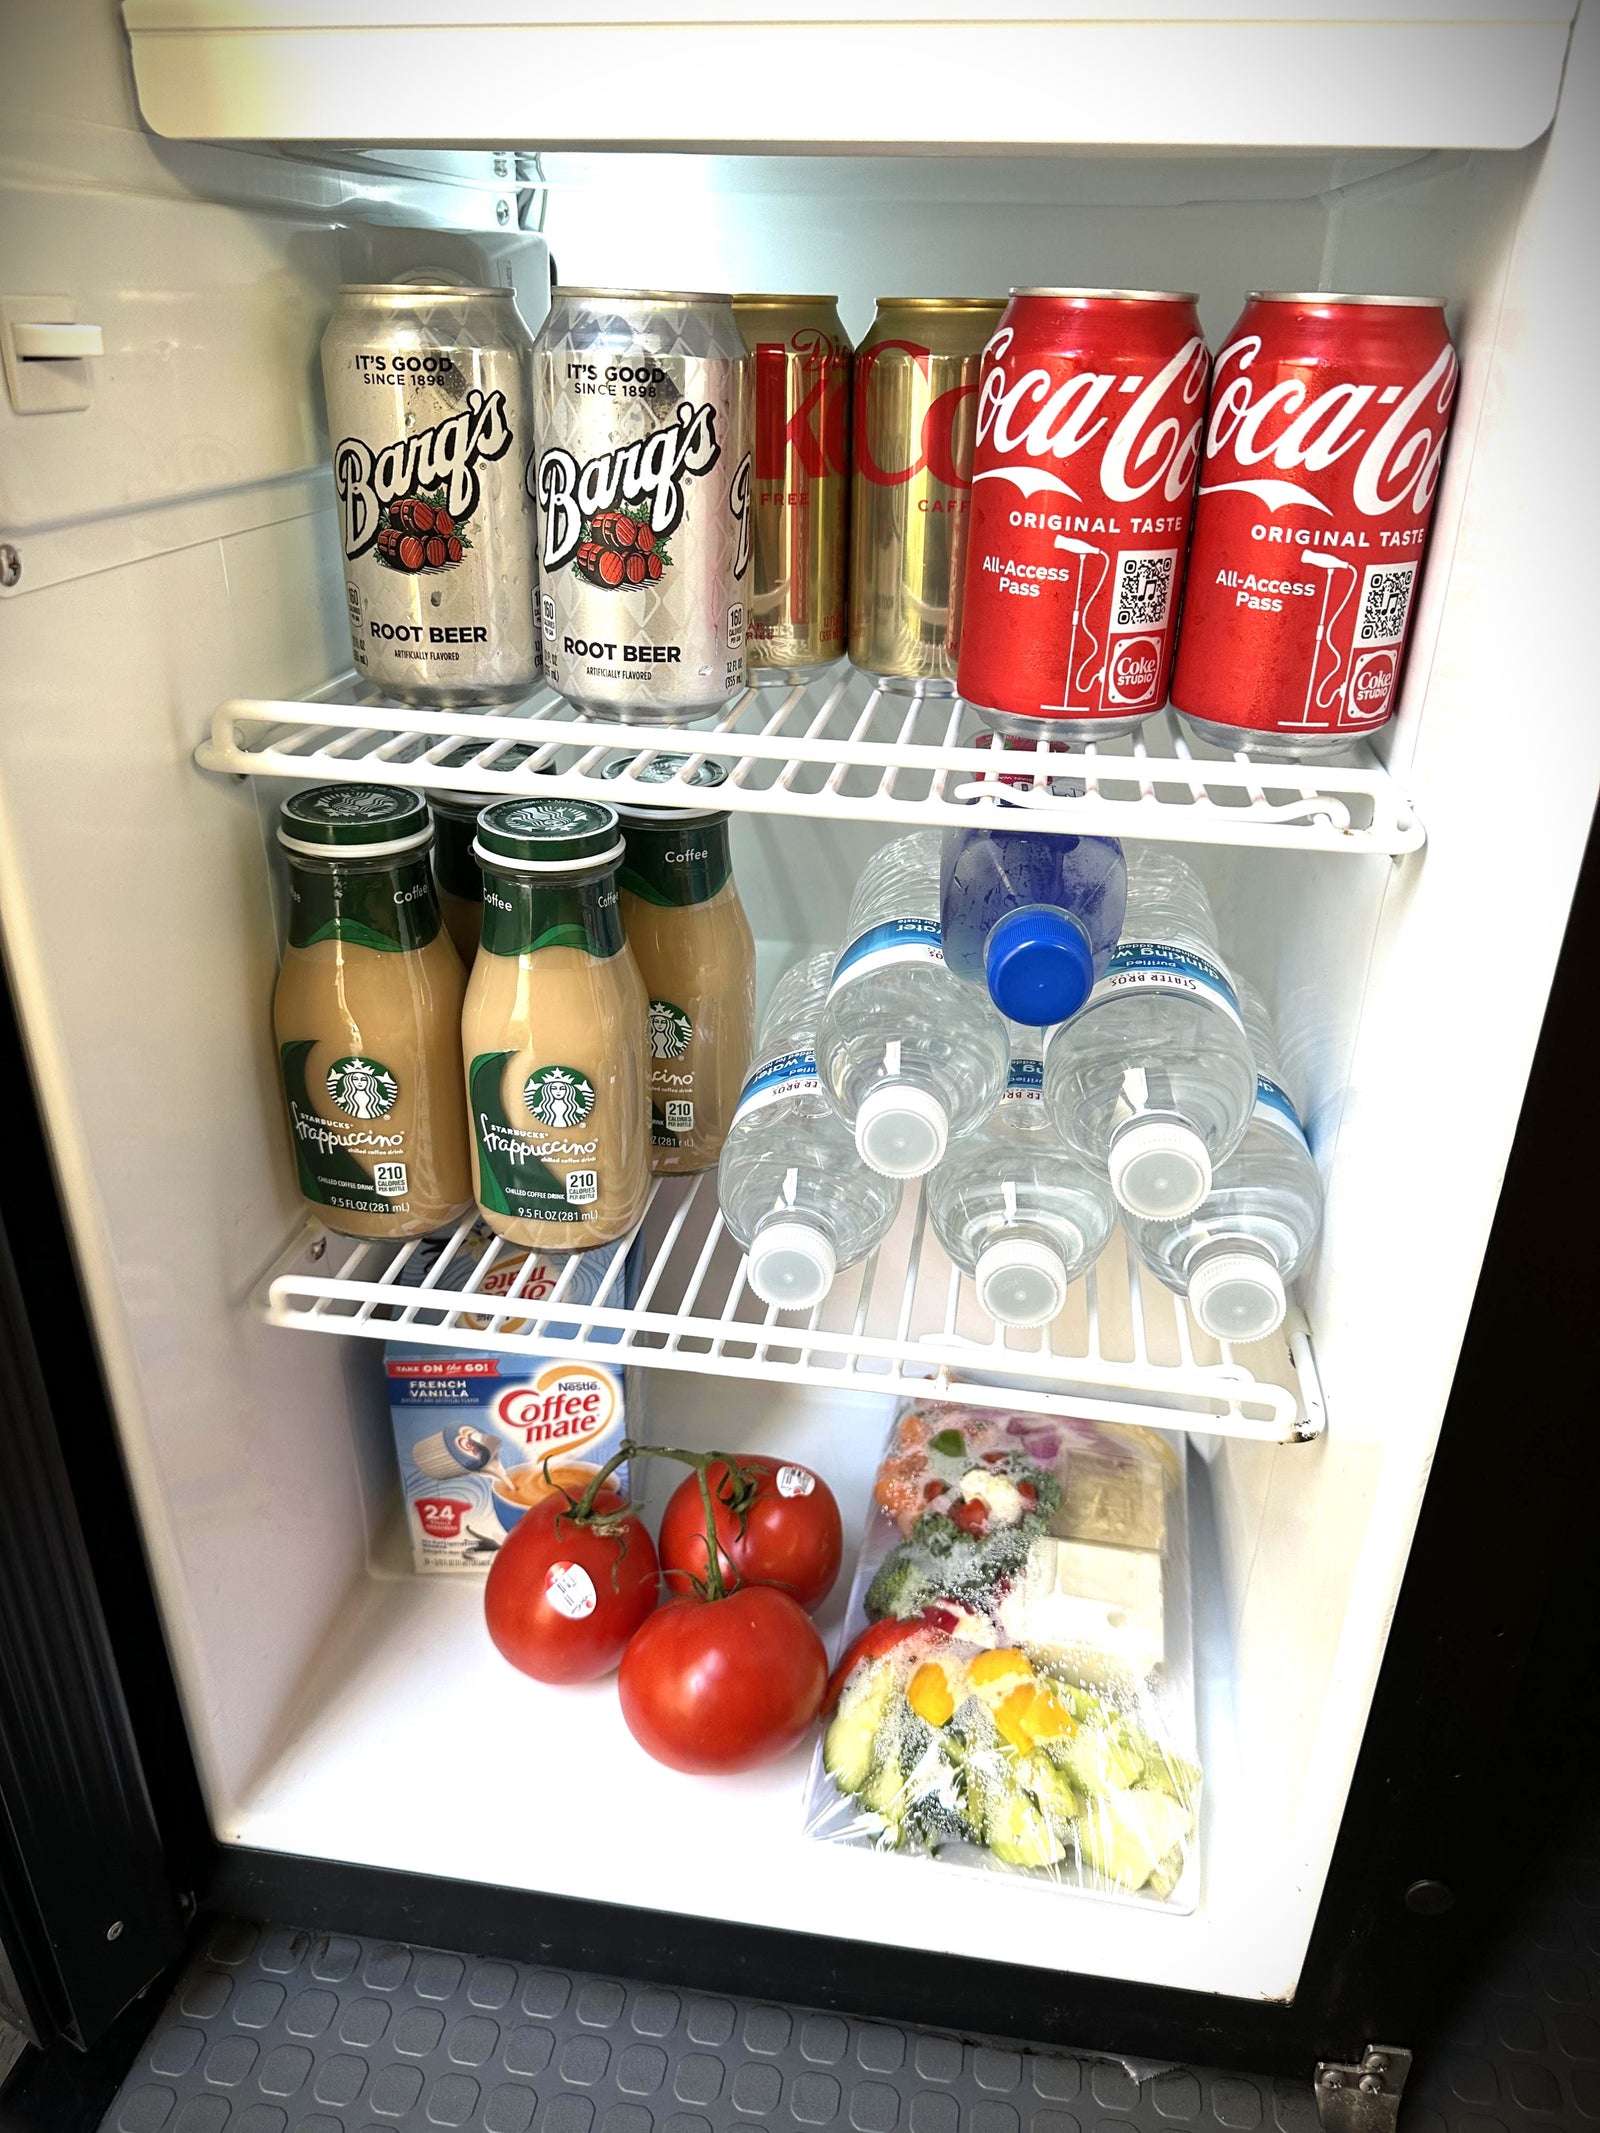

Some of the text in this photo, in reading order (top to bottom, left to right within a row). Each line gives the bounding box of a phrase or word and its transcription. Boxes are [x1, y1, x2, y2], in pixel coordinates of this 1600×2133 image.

[355, 355, 451, 372] IT'S GOOD
[364, 374, 445, 386] SINCE 1898
[567, 363, 665, 383] IT'S GOOD
[574, 383, 657, 398] SINCE 1898
[335, 389, 513, 561] Barq's
[537, 401, 720, 572] Barq's
[760, 493, 810, 506] FREE
[917, 499, 970, 513] CAFF
[1009, 510, 1183, 533] ORIGINAL TASTE
[1251, 524, 1425, 547] ORIGINAL TASTE
[982, 555, 1070, 582] All-Access
[998, 577, 1041, 598] Pass
[1215, 569, 1316, 596] All-Access
[1235, 590, 1283, 612] Pass
[370, 621, 488, 643] ROOT BEER
[394, 650, 460, 661] ARTIFICIALLY FLAVORED
[564, 636, 682, 663] ROOT BEER
[586, 666, 652, 681] ARTIFICIALLY FLAVORED
[1116, 656, 1156, 676] Coke
[1117, 673, 1153, 686] STUDIO
[1357, 670, 1391, 691] Coke
[1356, 688, 1388, 701] STUDIO
[665, 848, 708, 864] Coffee
[393, 883, 429, 905] Coffee
[484, 887, 513, 912] Coffee
[1118, 943, 1154, 951] added
[1126, 959, 1177, 969] purified
[1140, 946, 1220, 981] drinking
[1151, 973, 1197, 990] STATER
[752, 1058, 799, 1085] water
[669, 1103, 690, 1116] 210
[300, 1112, 352, 1130] STARBUCKS
[490, 1124, 547, 1139] STARBUCKS
[658, 1136, 676, 1147] (281
[377, 1166, 403, 1180] 210
[570, 1173, 594, 1188] 210
[317, 1175, 338, 1186] CHILLED
[337, 1180, 357, 1190] COFFEE
[568, 1187, 596, 1195] CALORIES
[505, 1187, 527, 1197] CHILLED
[526, 1191, 547, 1199] COFFEE
[330, 1196, 410, 1213] 9.5 FL OZ (281 mL)
[518, 1207, 598, 1222] 9.5 FL OZ (281 mL)
[423, 1364, 443, 1373] ON
[446, 1363, 462, 1374] the
[464, 1363, 489, 1372] GO!
[409, 1380, 467, 1388] FRENCH
[410, 1389, 469, 1397] VANILLA
[499, 1389, 601, 1428] Coffee
[526, 1414, 597, 1444] mate
[423, 1503, 456, 1521] 24
